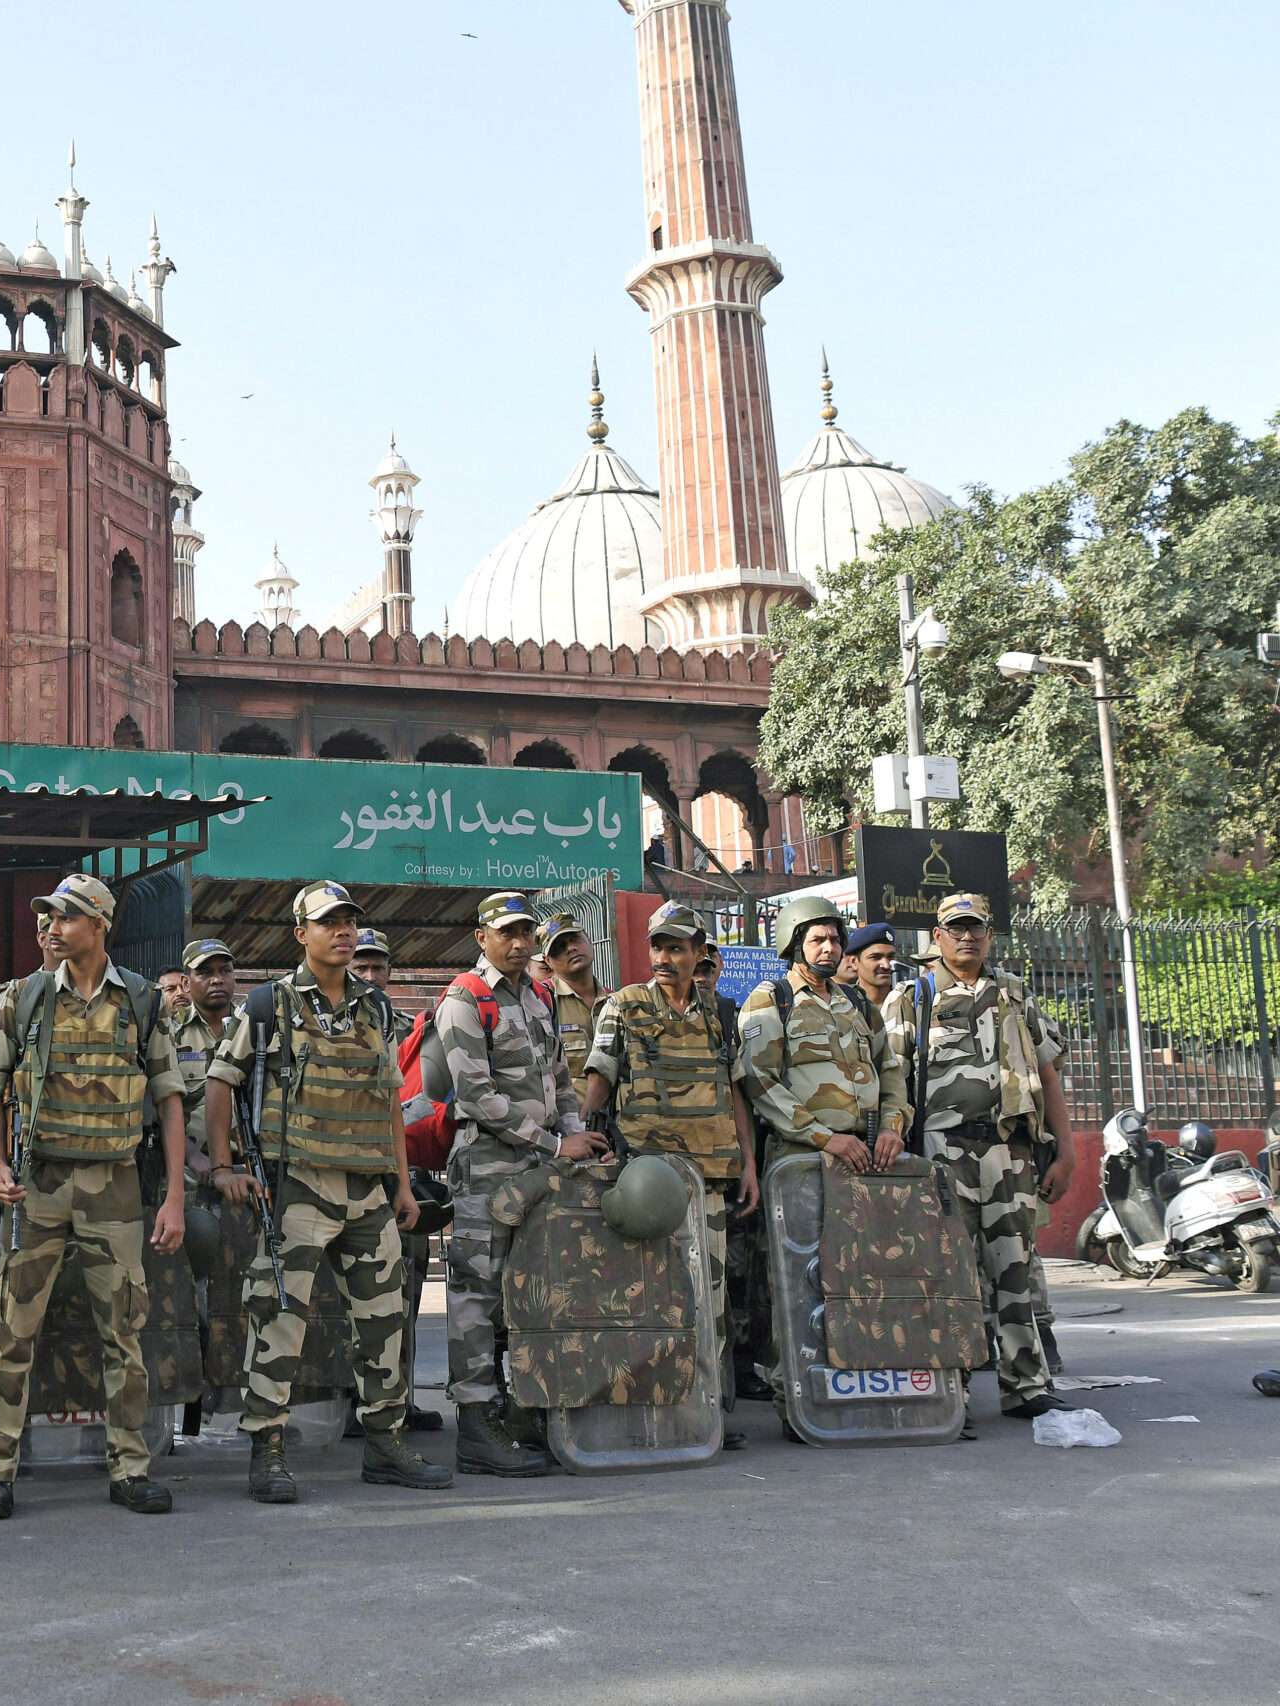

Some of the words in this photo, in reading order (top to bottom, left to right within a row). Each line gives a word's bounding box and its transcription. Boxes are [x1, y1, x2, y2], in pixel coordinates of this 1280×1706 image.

[332, 787, 453, 850] الغفور
[458, 800, 537, 847] عبد
[543, 796, 622, 850] باب
[404, 862, 455, 878] Courtesy
[459, 864, 474, 880] by
[486, 859, 539, 878] Hovel
[545, 861, 621, 882] Autogas
[724, 951, 749, 960] JAMA
[760, 962, 788, 971] EMPE
[759, 973, 779, 981] 1656
[832, 1369, 908, 1395] CISF
